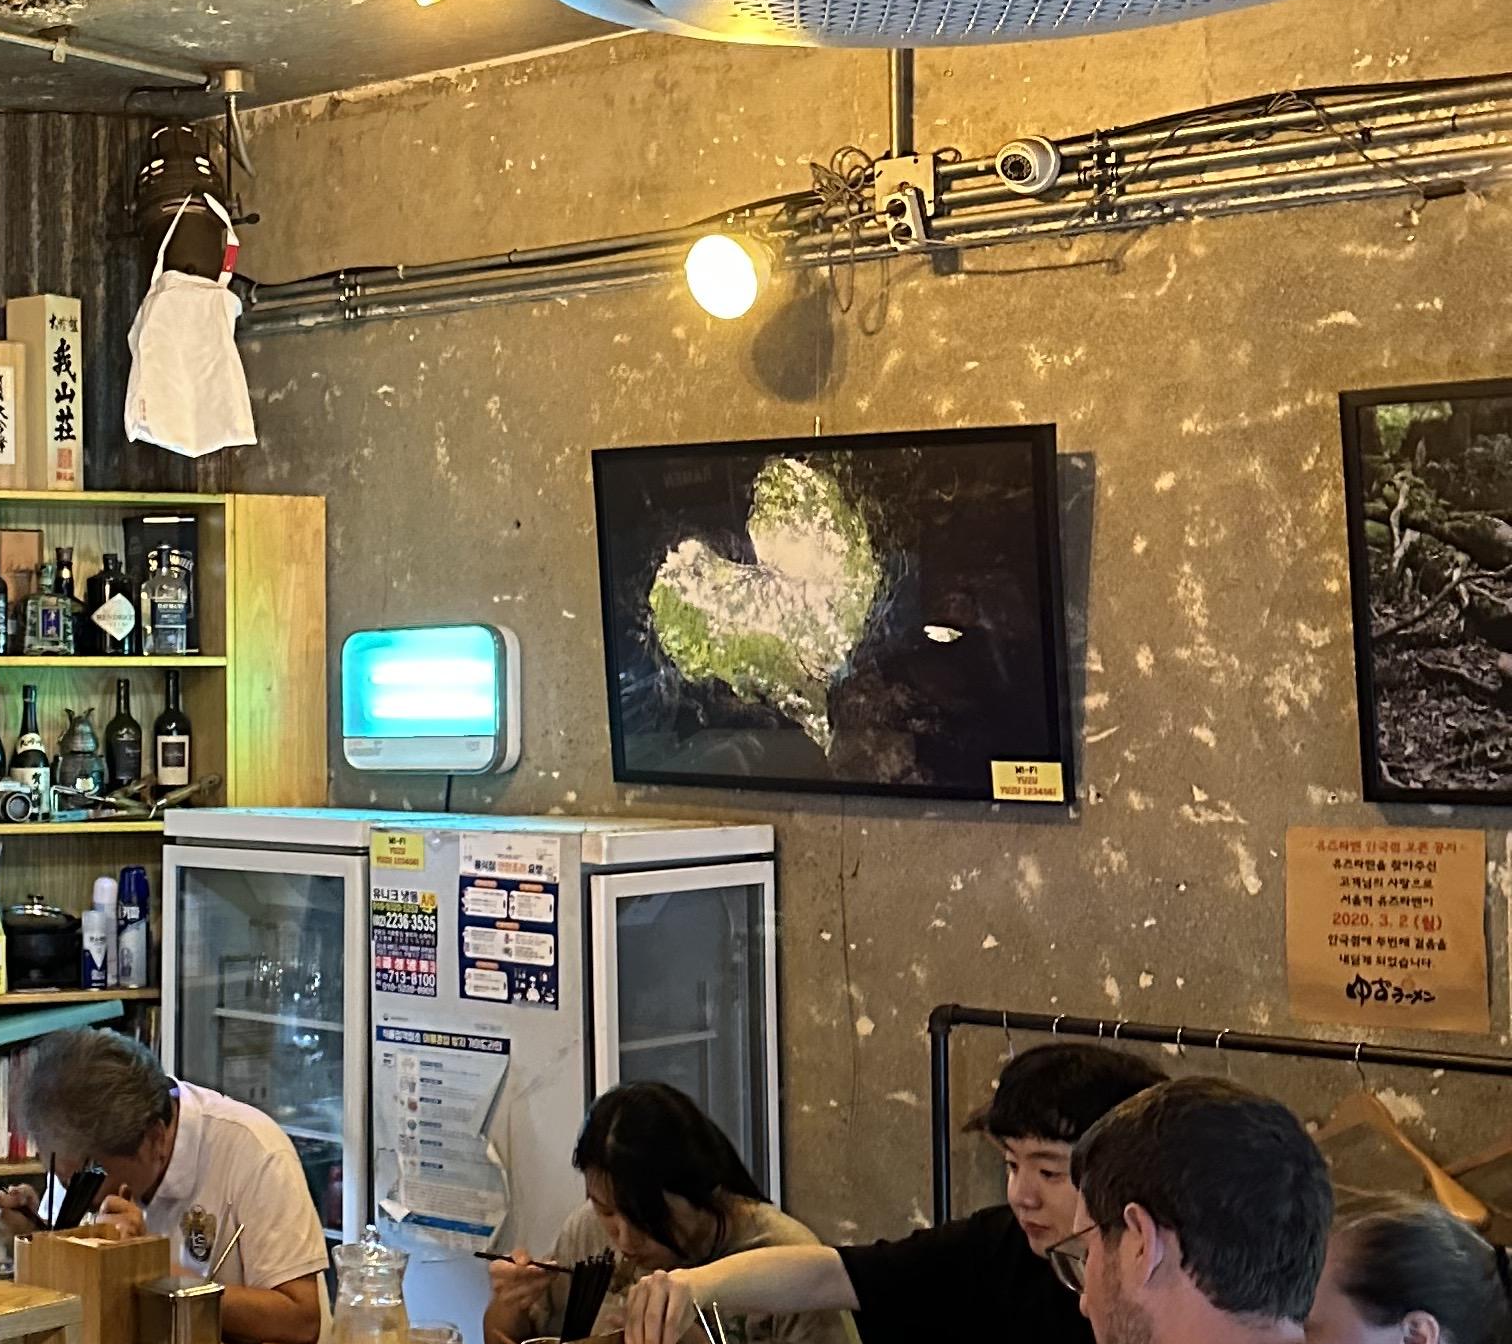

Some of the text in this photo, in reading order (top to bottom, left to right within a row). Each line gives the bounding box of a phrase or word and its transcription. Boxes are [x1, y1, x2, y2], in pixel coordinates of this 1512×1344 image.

[1345, 973, 1436, 1007] ゆずラーメン
